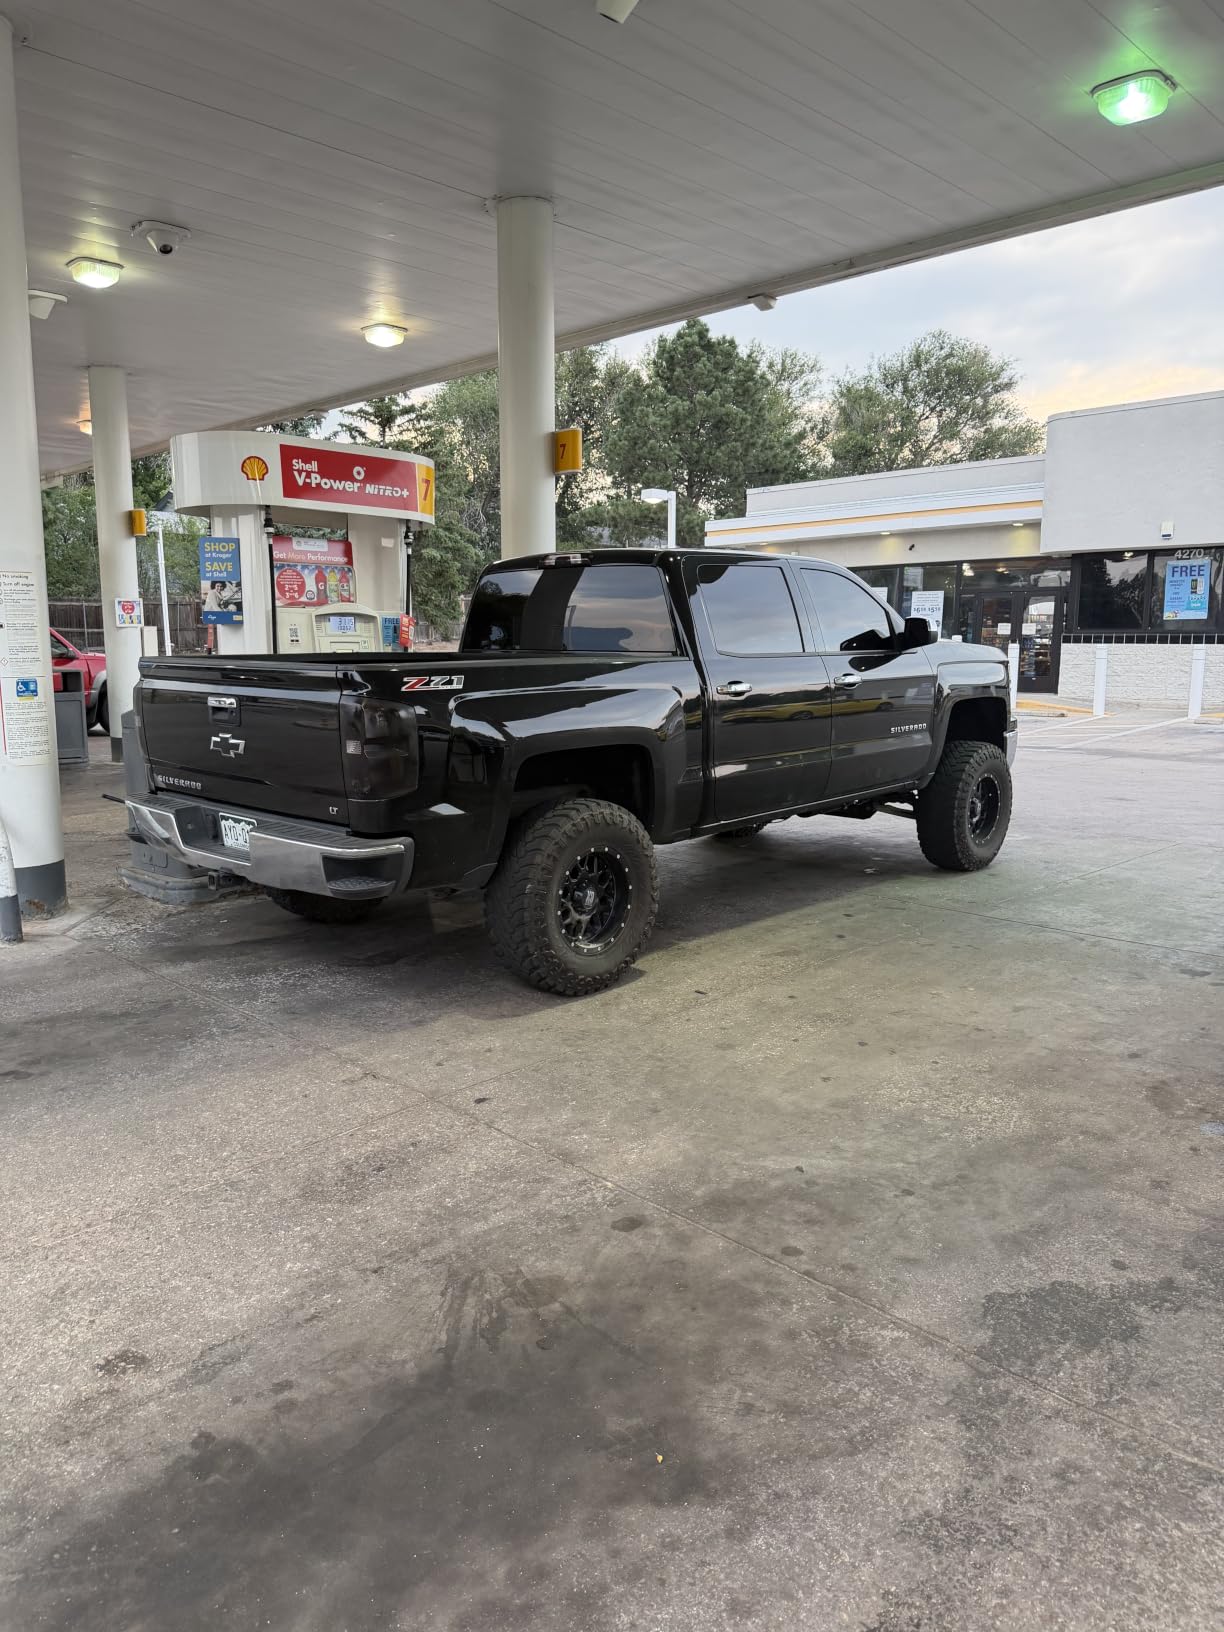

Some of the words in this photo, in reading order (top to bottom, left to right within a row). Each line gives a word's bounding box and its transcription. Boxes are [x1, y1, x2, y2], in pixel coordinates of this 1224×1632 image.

[559, 443, 567, 460] 7
[292, 458, 318, 472] Shell
[293, 470, 361, 493] V-Power
[421, 478, 431, 501] 7
[204, 542, 236, 552] SHOP
[1174, 548, 1205, 559] 4270
[273, 551, 286, 559] Get
[287, 551, 306, 560] More
[307, 552, 348, 563] Performance
[205, 561, 233, 572] SAVE
[1171, 564, 1206, 578] FREE
[384, 617, 400, 625] FREE
[400, 675, 465, 691] Z71
[890, 723, 927, 734] SILVERADO
[158, 774, 202, 790] SILVERADO
